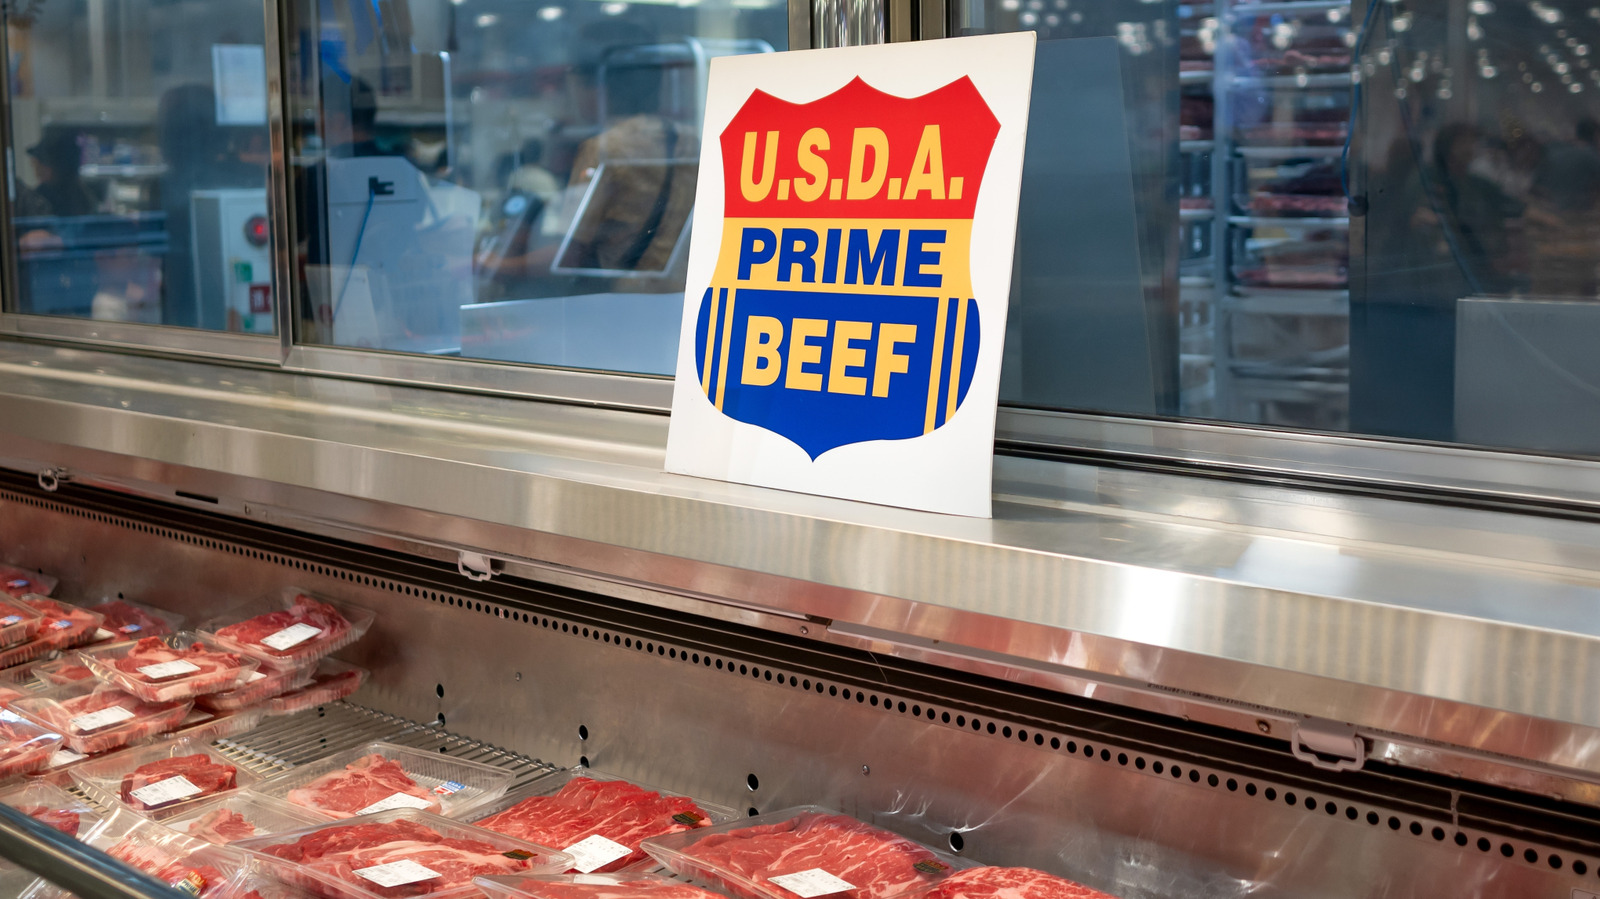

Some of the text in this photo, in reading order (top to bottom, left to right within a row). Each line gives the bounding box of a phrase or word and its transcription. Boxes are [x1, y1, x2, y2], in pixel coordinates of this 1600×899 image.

[739, 124, 965, 202] U.S.D.A.
[737, 228, 947, 287] PRIME
[740, 315, 918, 398] BEEF
